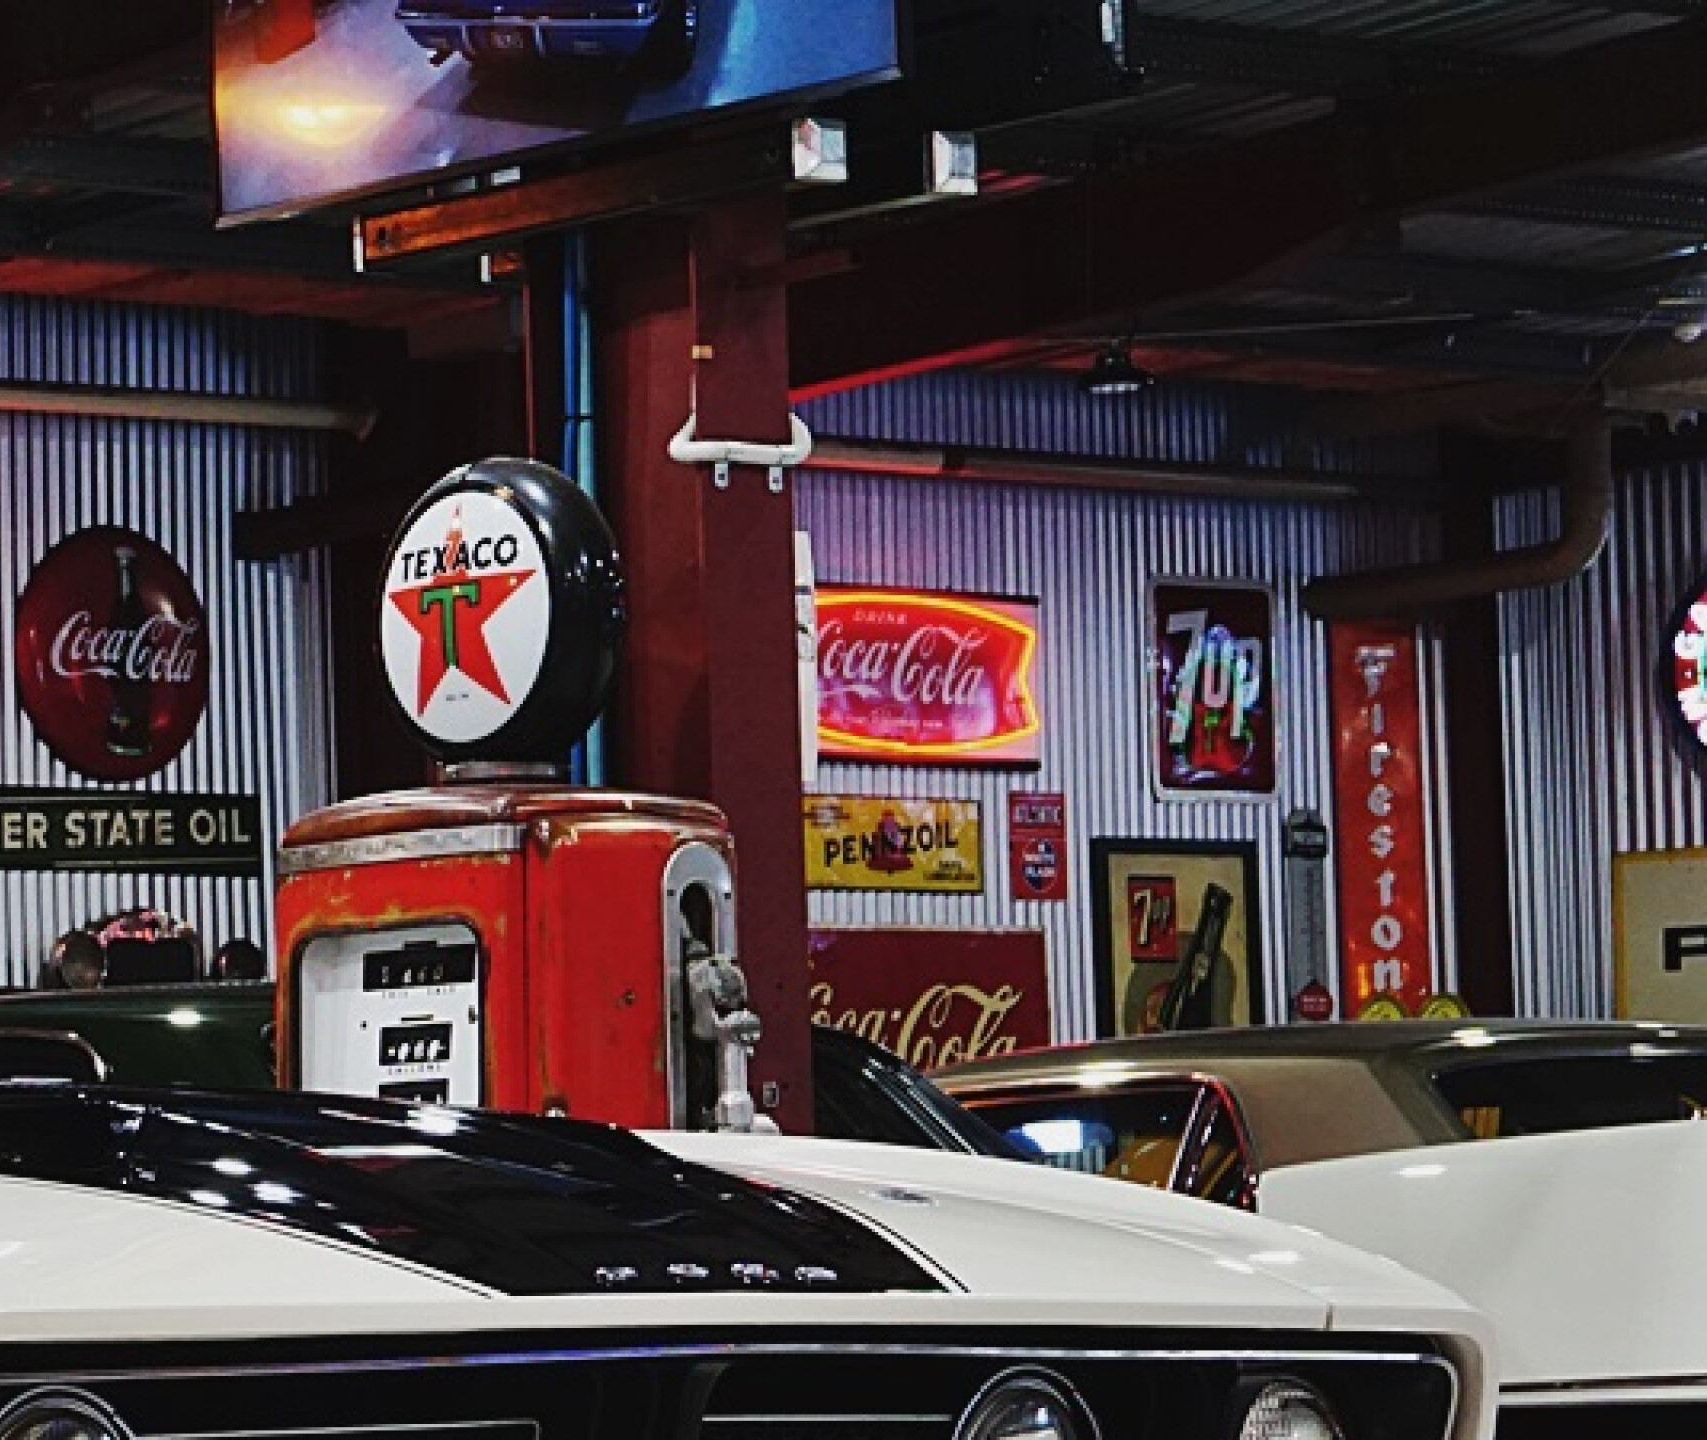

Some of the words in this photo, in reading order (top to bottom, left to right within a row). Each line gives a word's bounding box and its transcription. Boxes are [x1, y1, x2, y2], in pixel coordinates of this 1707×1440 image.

[400, 533, 519, 584] TEXACO
[419, 584, 482, 667] T
[64, 811, 176, 850] STATE
[190, 805, 251, 845] OIL
[1353, 645, 1405, 992] Fireston
[824, 821, 959, 868] PENNZOIL
